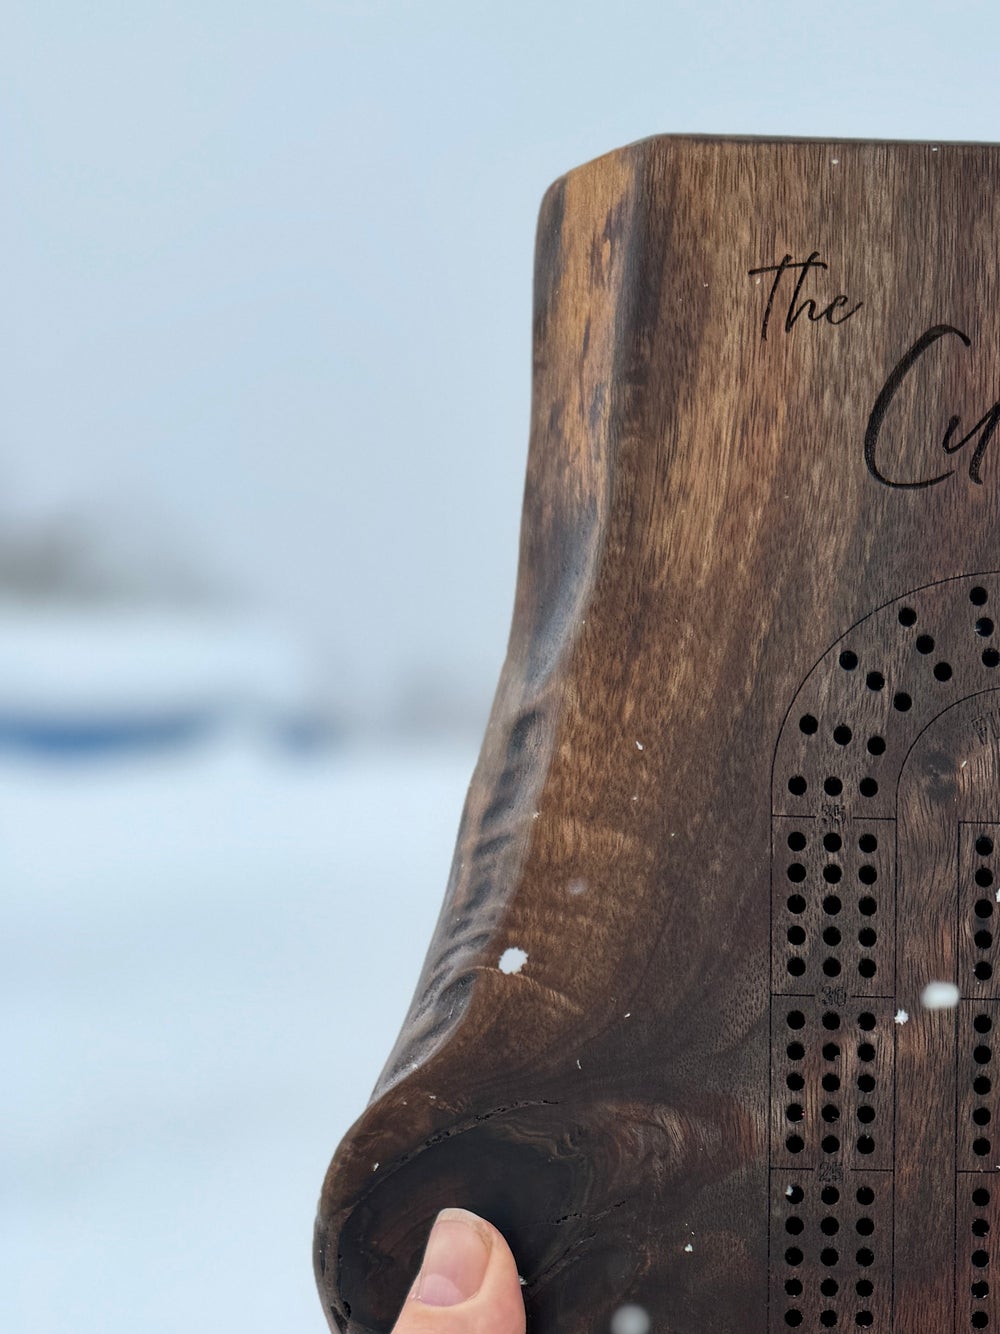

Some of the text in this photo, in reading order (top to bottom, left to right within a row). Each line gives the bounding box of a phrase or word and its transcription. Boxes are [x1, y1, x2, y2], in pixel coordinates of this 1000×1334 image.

[748, 250, 864, 340] The
[820, 804, 847, 826] 35
[821, 985, 847, 1006] 30
[818, 1161, 844, 1182] 25
